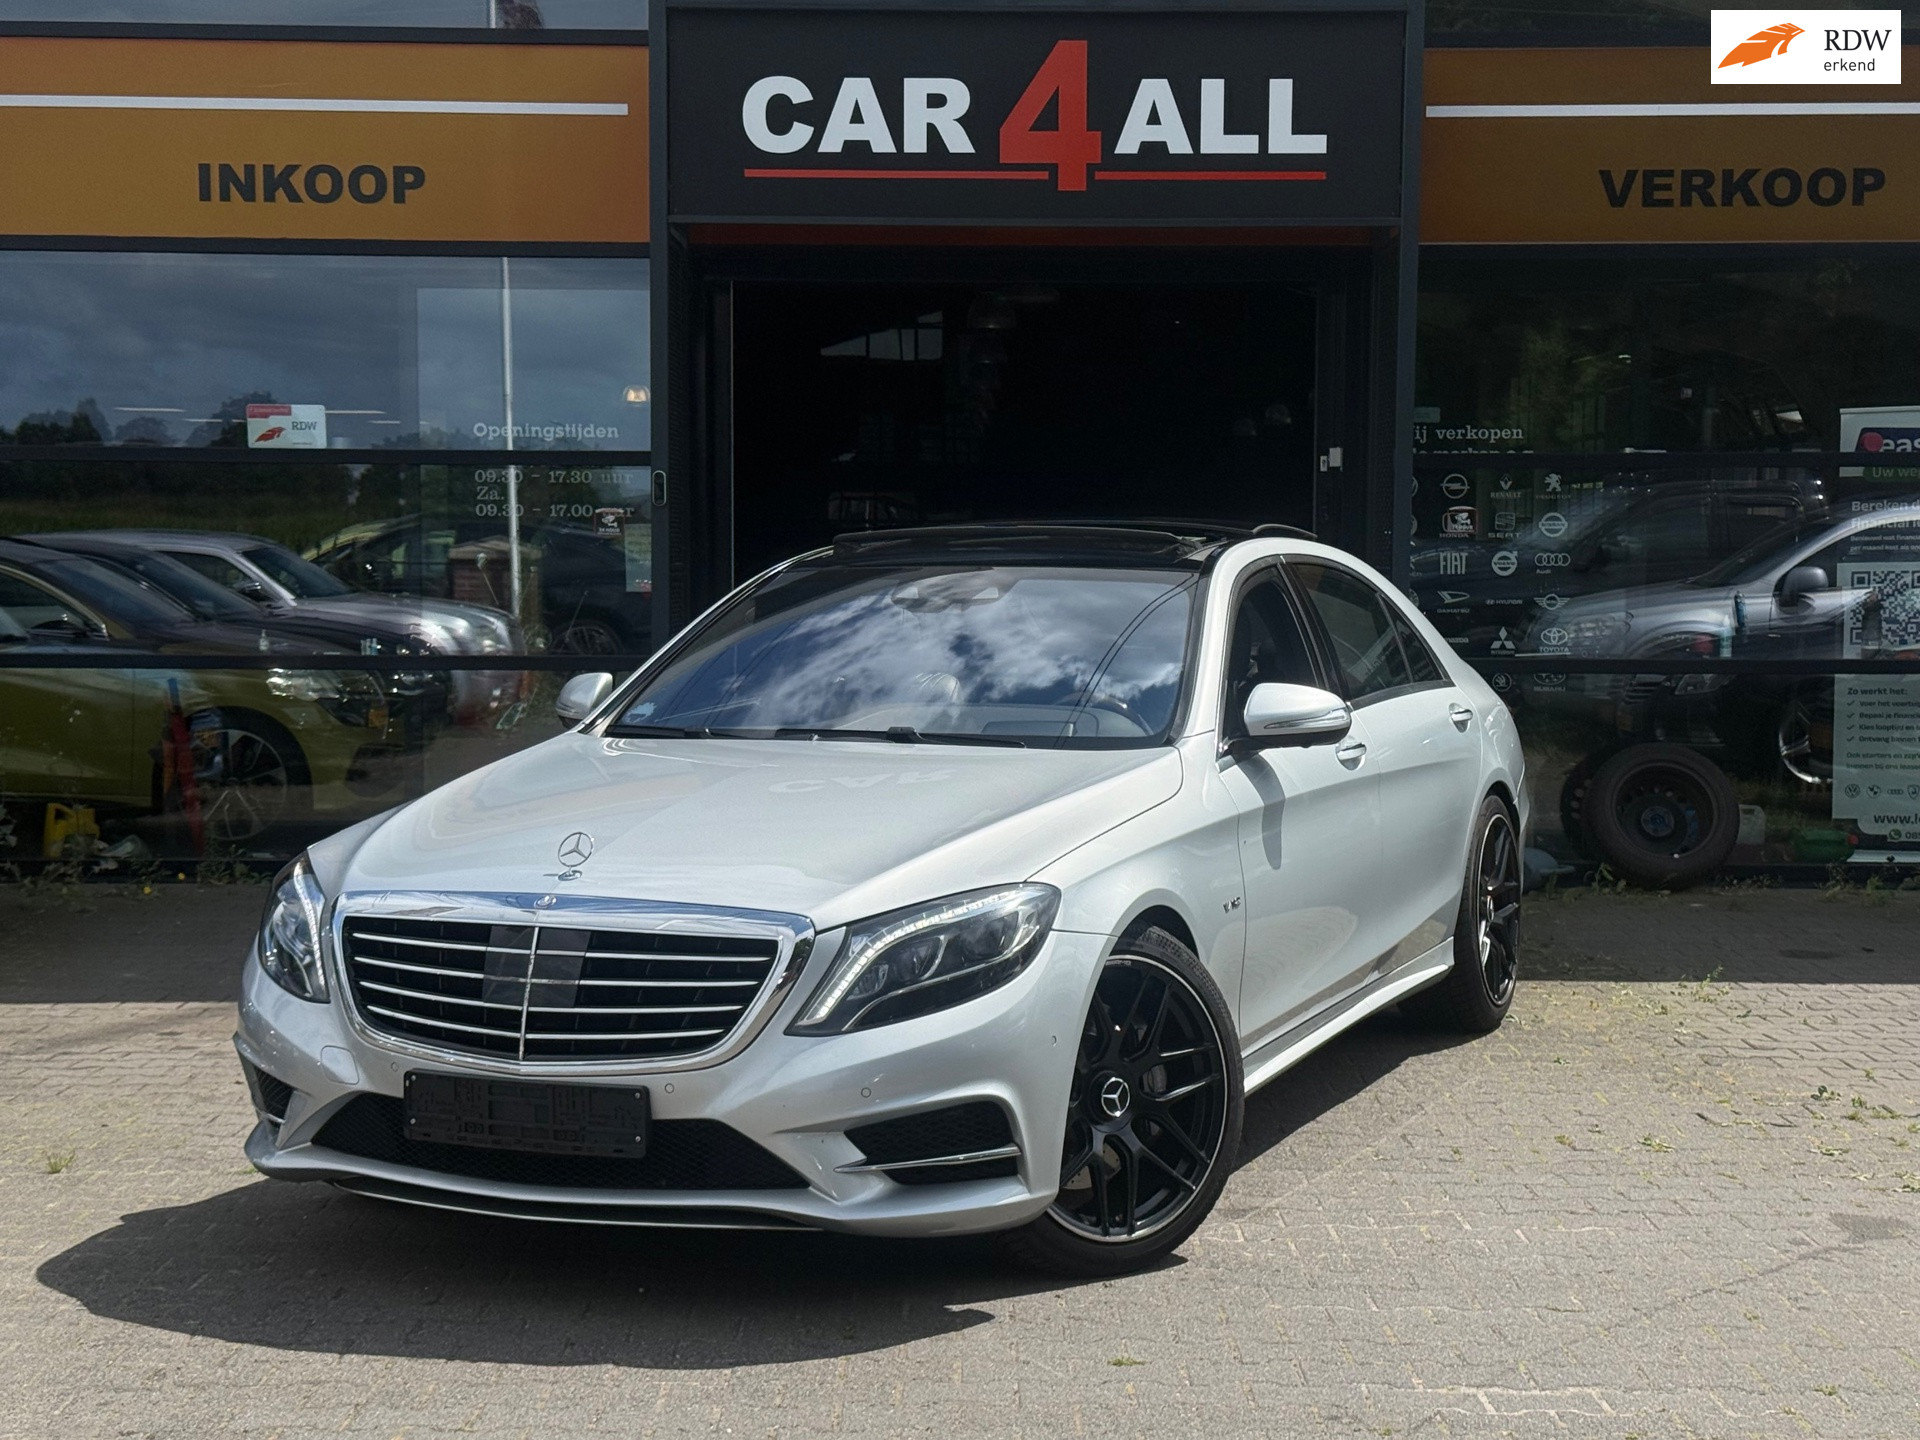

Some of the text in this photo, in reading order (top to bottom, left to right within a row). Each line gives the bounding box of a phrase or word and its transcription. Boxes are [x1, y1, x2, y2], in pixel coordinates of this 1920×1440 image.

[742, 39, 1327, 191] CAR 4 ALL
[198, 163, 426, 204] INKOOP
[1598, 167, 1886, 208] VERKOOP
[291, 421, 318, 431] RDW
[473, 423, 619, 441] Openingstijden
[1412, 425, 1524, 443] ij verkopen
[474, 469, 523, 484] 09.30
[548, 469, 592, 484] 17.30
[601, 473, 634, 484] uur
[1872, 467, 1894, 477] Uw
[476, 485, 505, 500] Za.
[475, 503, 524, 518] 09.30
[549, 503, 593, 518] 17.00
[1851, 500, 1907, 511] Bereken
[1439, 551, 1469, 575] FIAT
